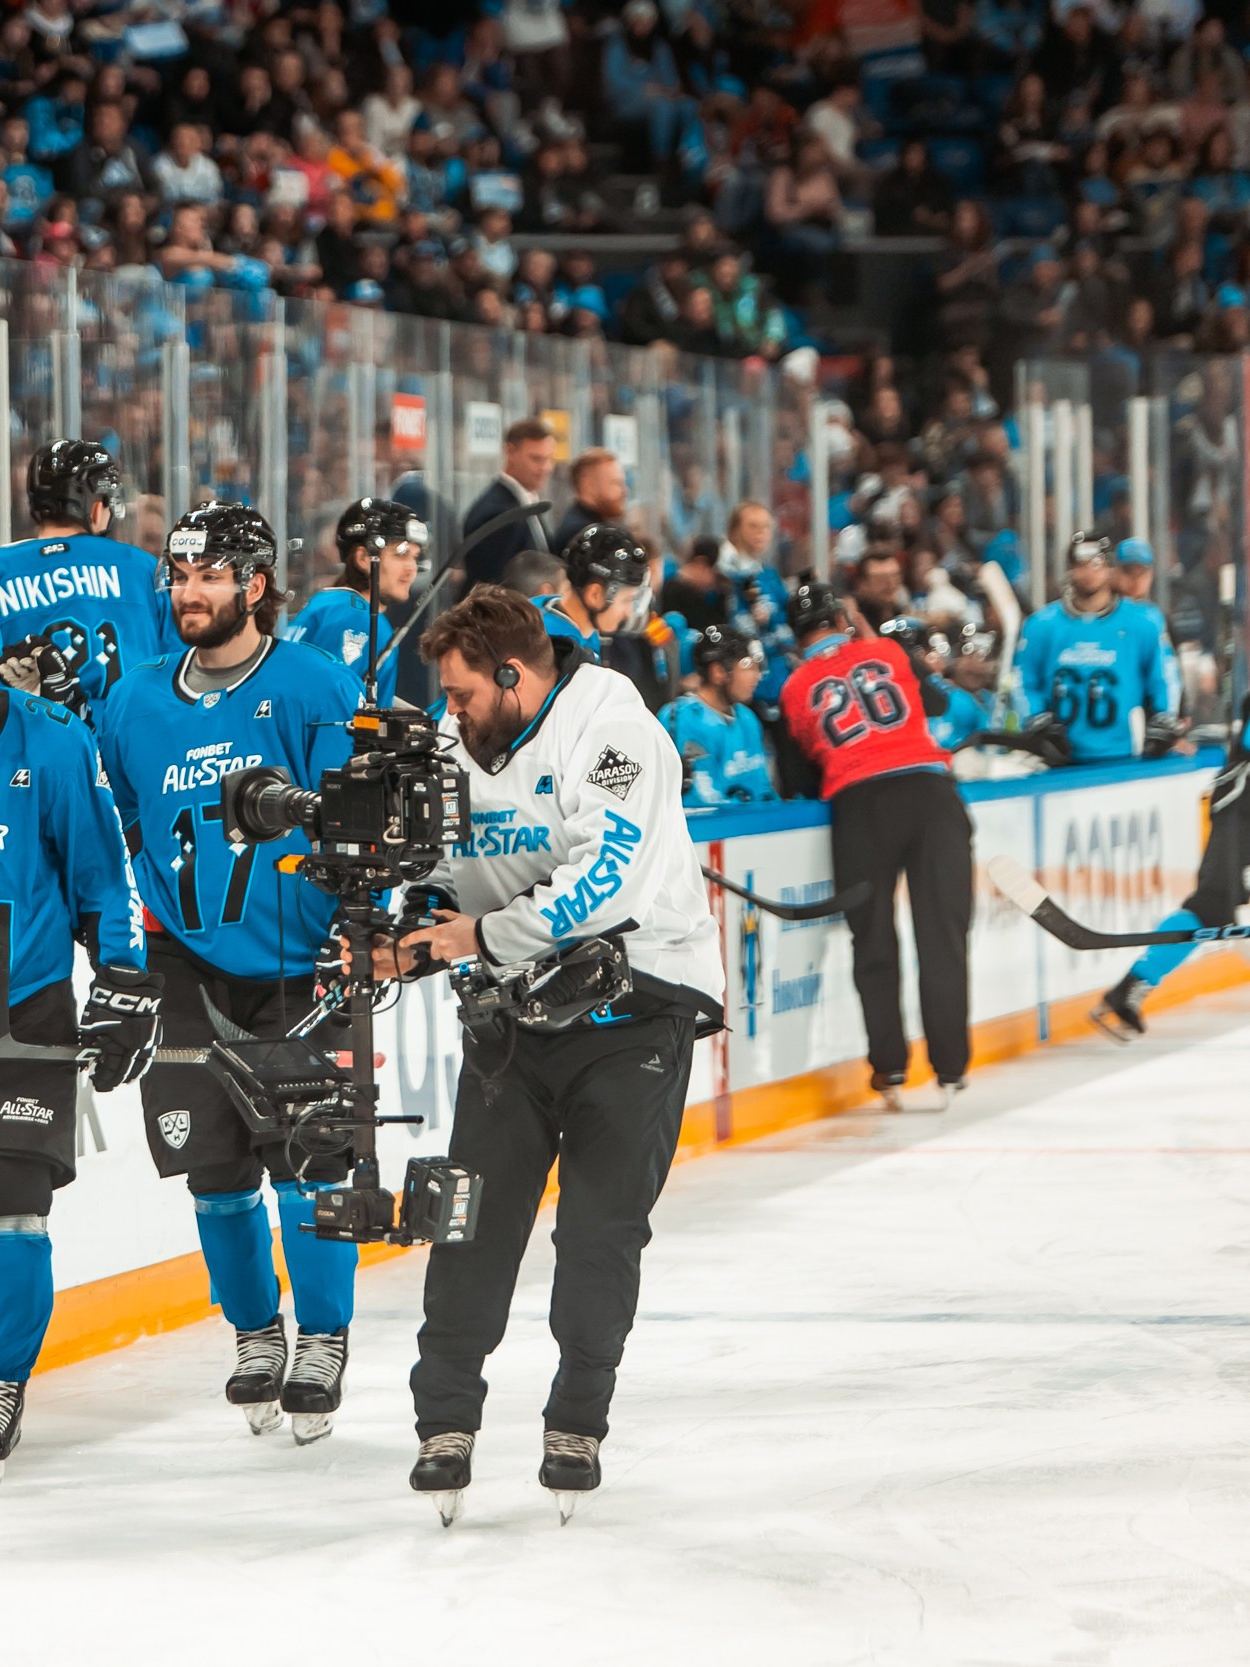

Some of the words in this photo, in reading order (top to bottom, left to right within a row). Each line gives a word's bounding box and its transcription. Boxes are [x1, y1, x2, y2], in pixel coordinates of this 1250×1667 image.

[810, 658, 912, 748] 26
[186, 742, 233, 762] FONBET
[590, 763, 639, 783] TARASOV
[169, 800, 261, 934] 17
[91, 986, 162, 1014] CCM
